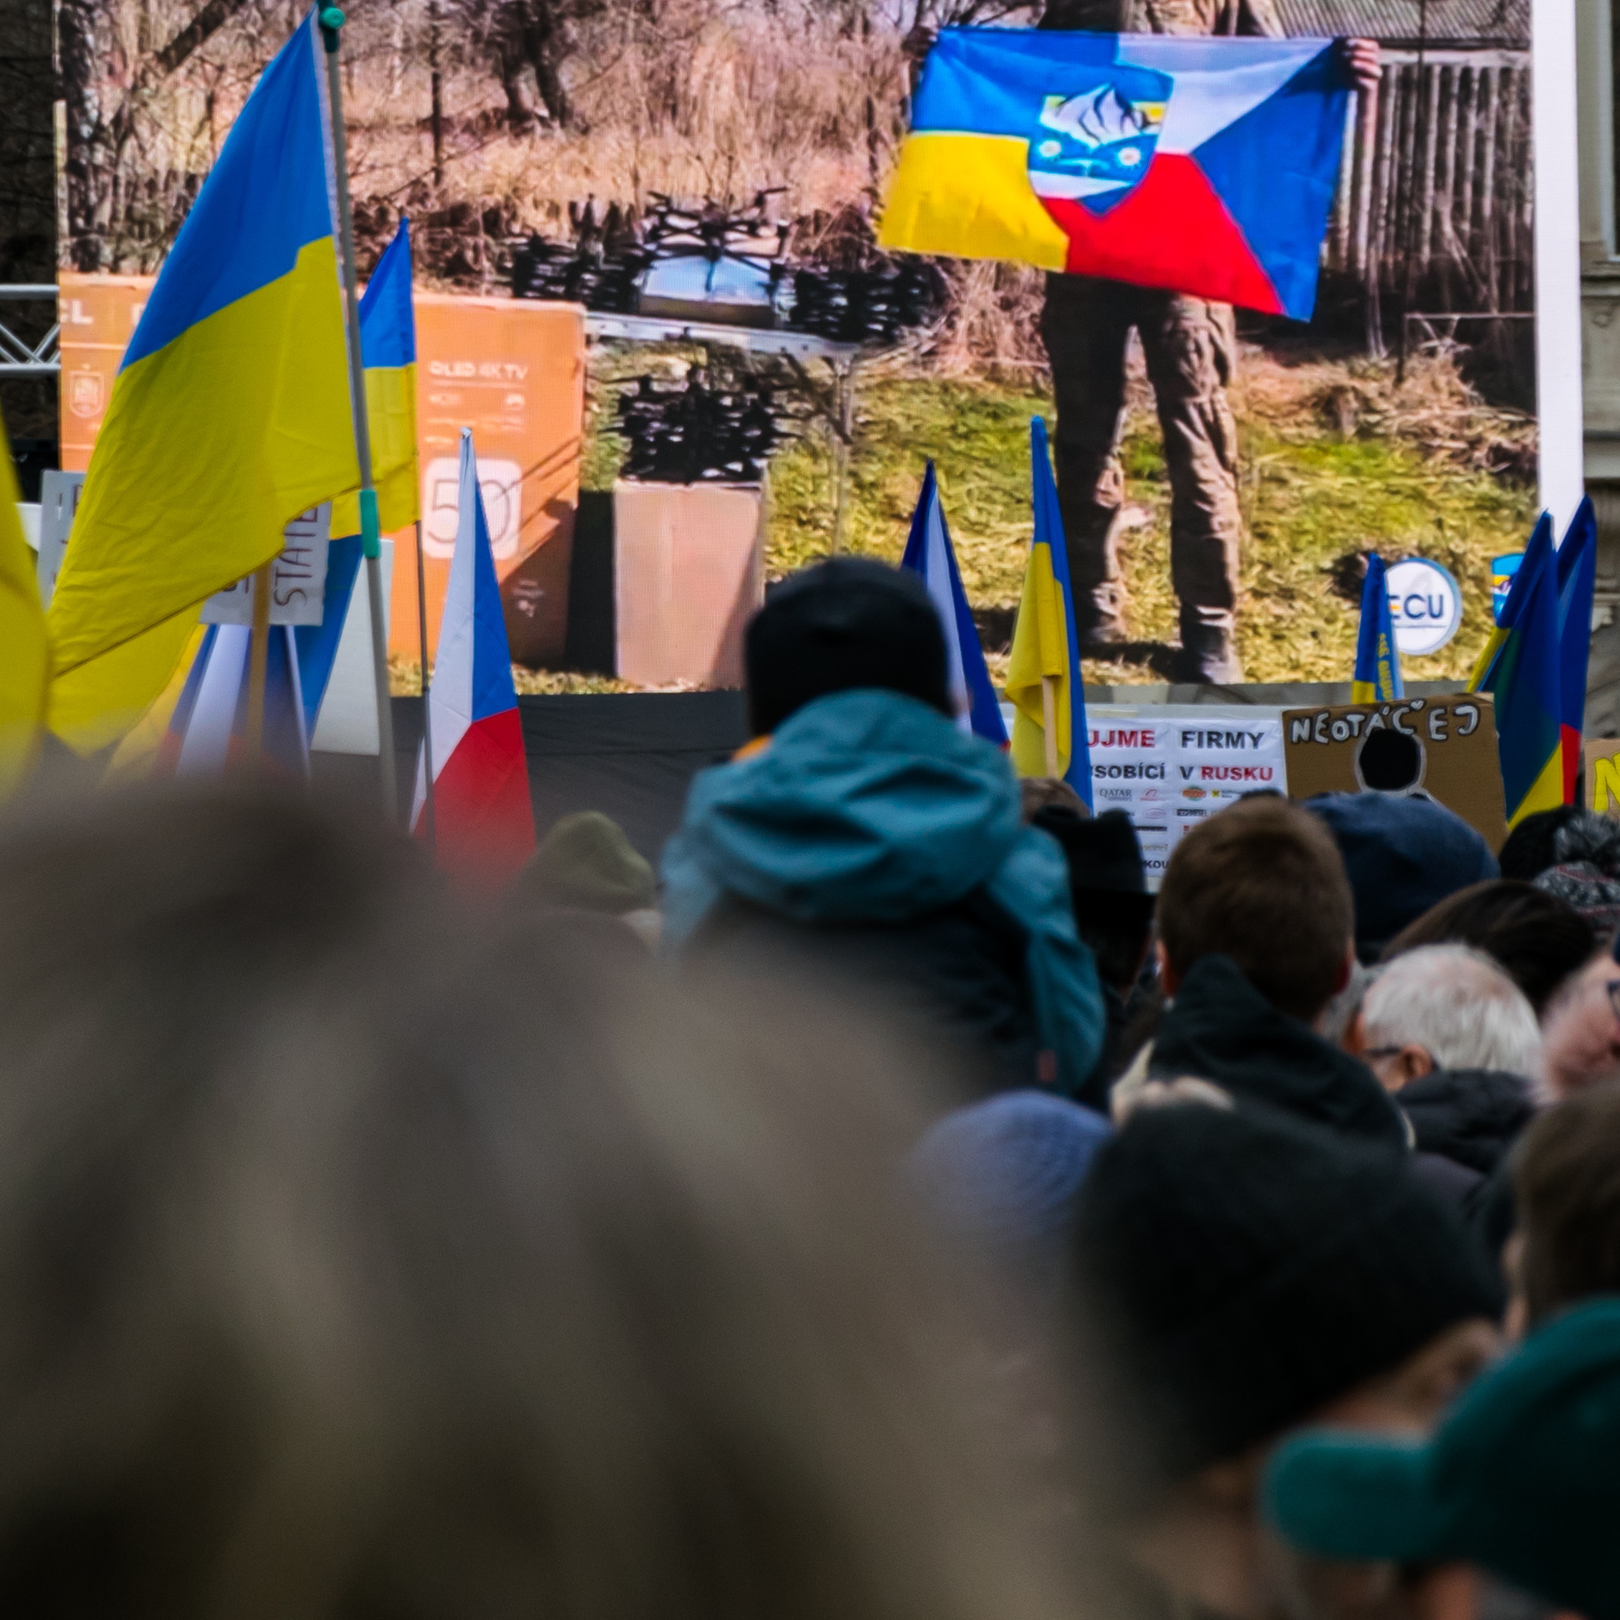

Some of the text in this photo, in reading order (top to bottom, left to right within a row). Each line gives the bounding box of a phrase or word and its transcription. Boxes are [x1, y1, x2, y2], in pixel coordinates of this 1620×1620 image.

[1181, 730, 1265, 750] FIRMY
[1091, 762, 1273, 781] SOBÍCÍ V RUSKU
[1100, 788, 1132, 798] QATAR
